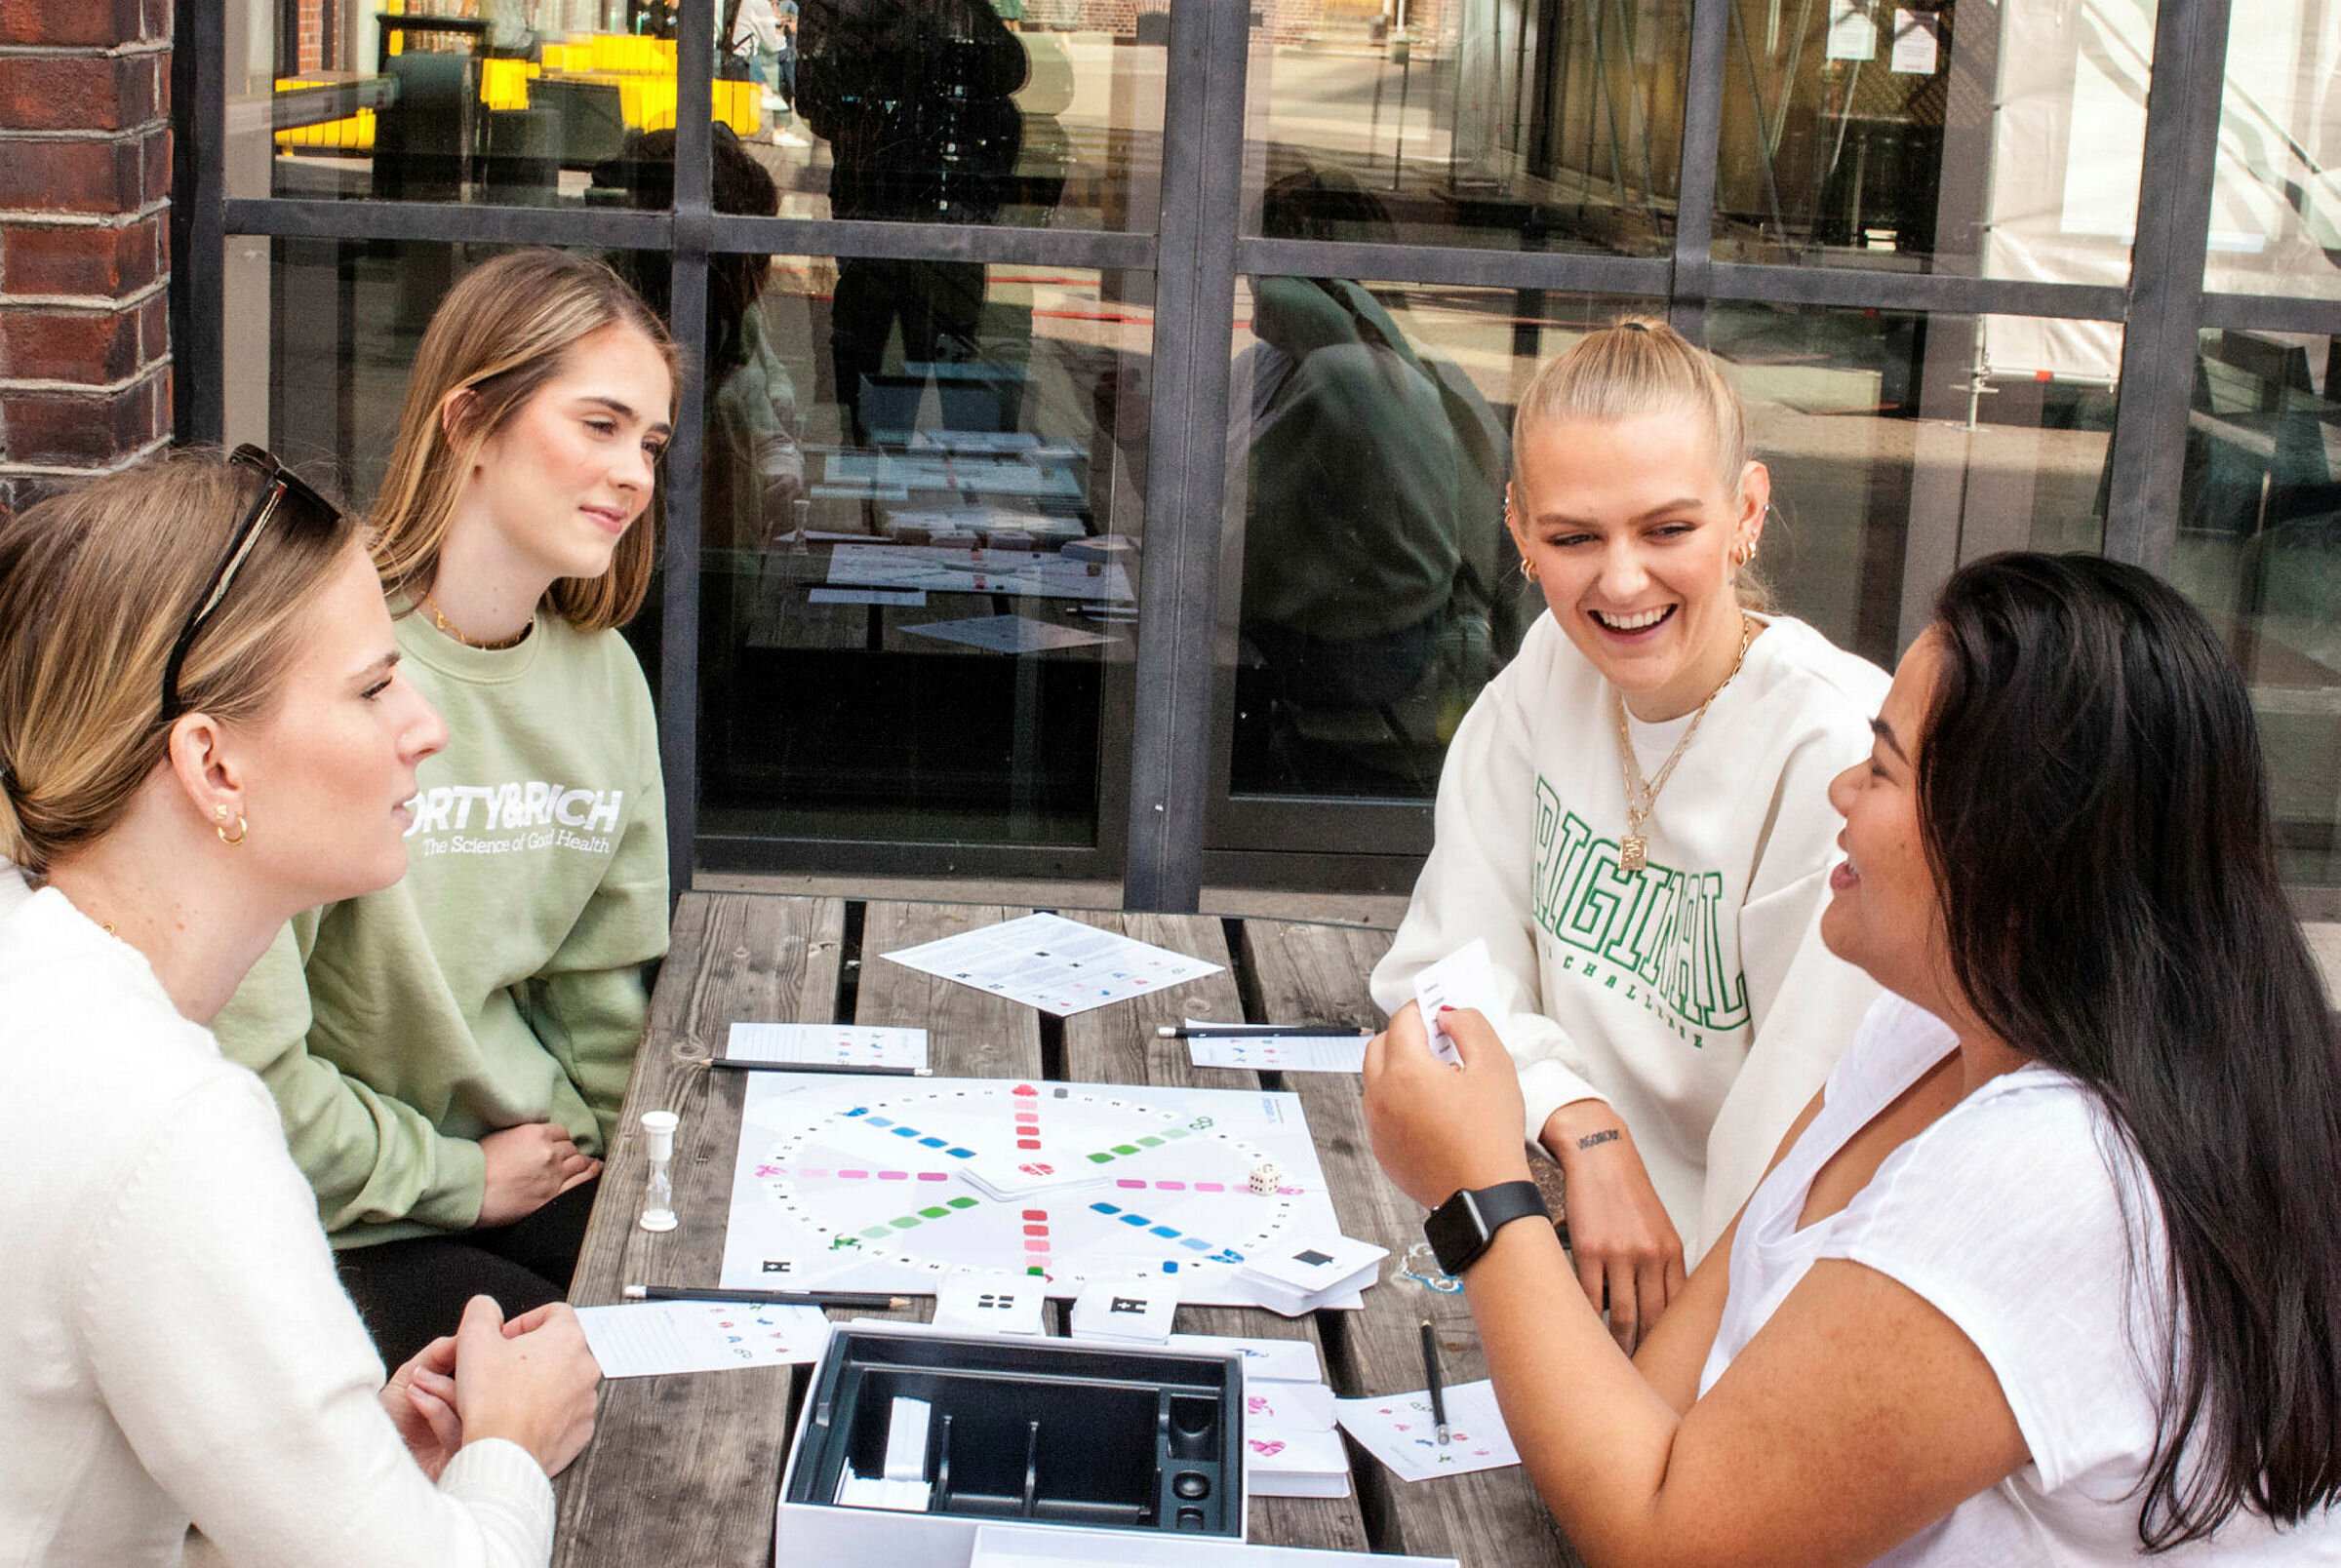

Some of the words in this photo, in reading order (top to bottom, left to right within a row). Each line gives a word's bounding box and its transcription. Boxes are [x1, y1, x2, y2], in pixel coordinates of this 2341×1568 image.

[423, 839, 448, 855] The
[451, 836, 510, 854] Science
[512, 834, 527, 851] of
[556, 829, 611, 853] Health
